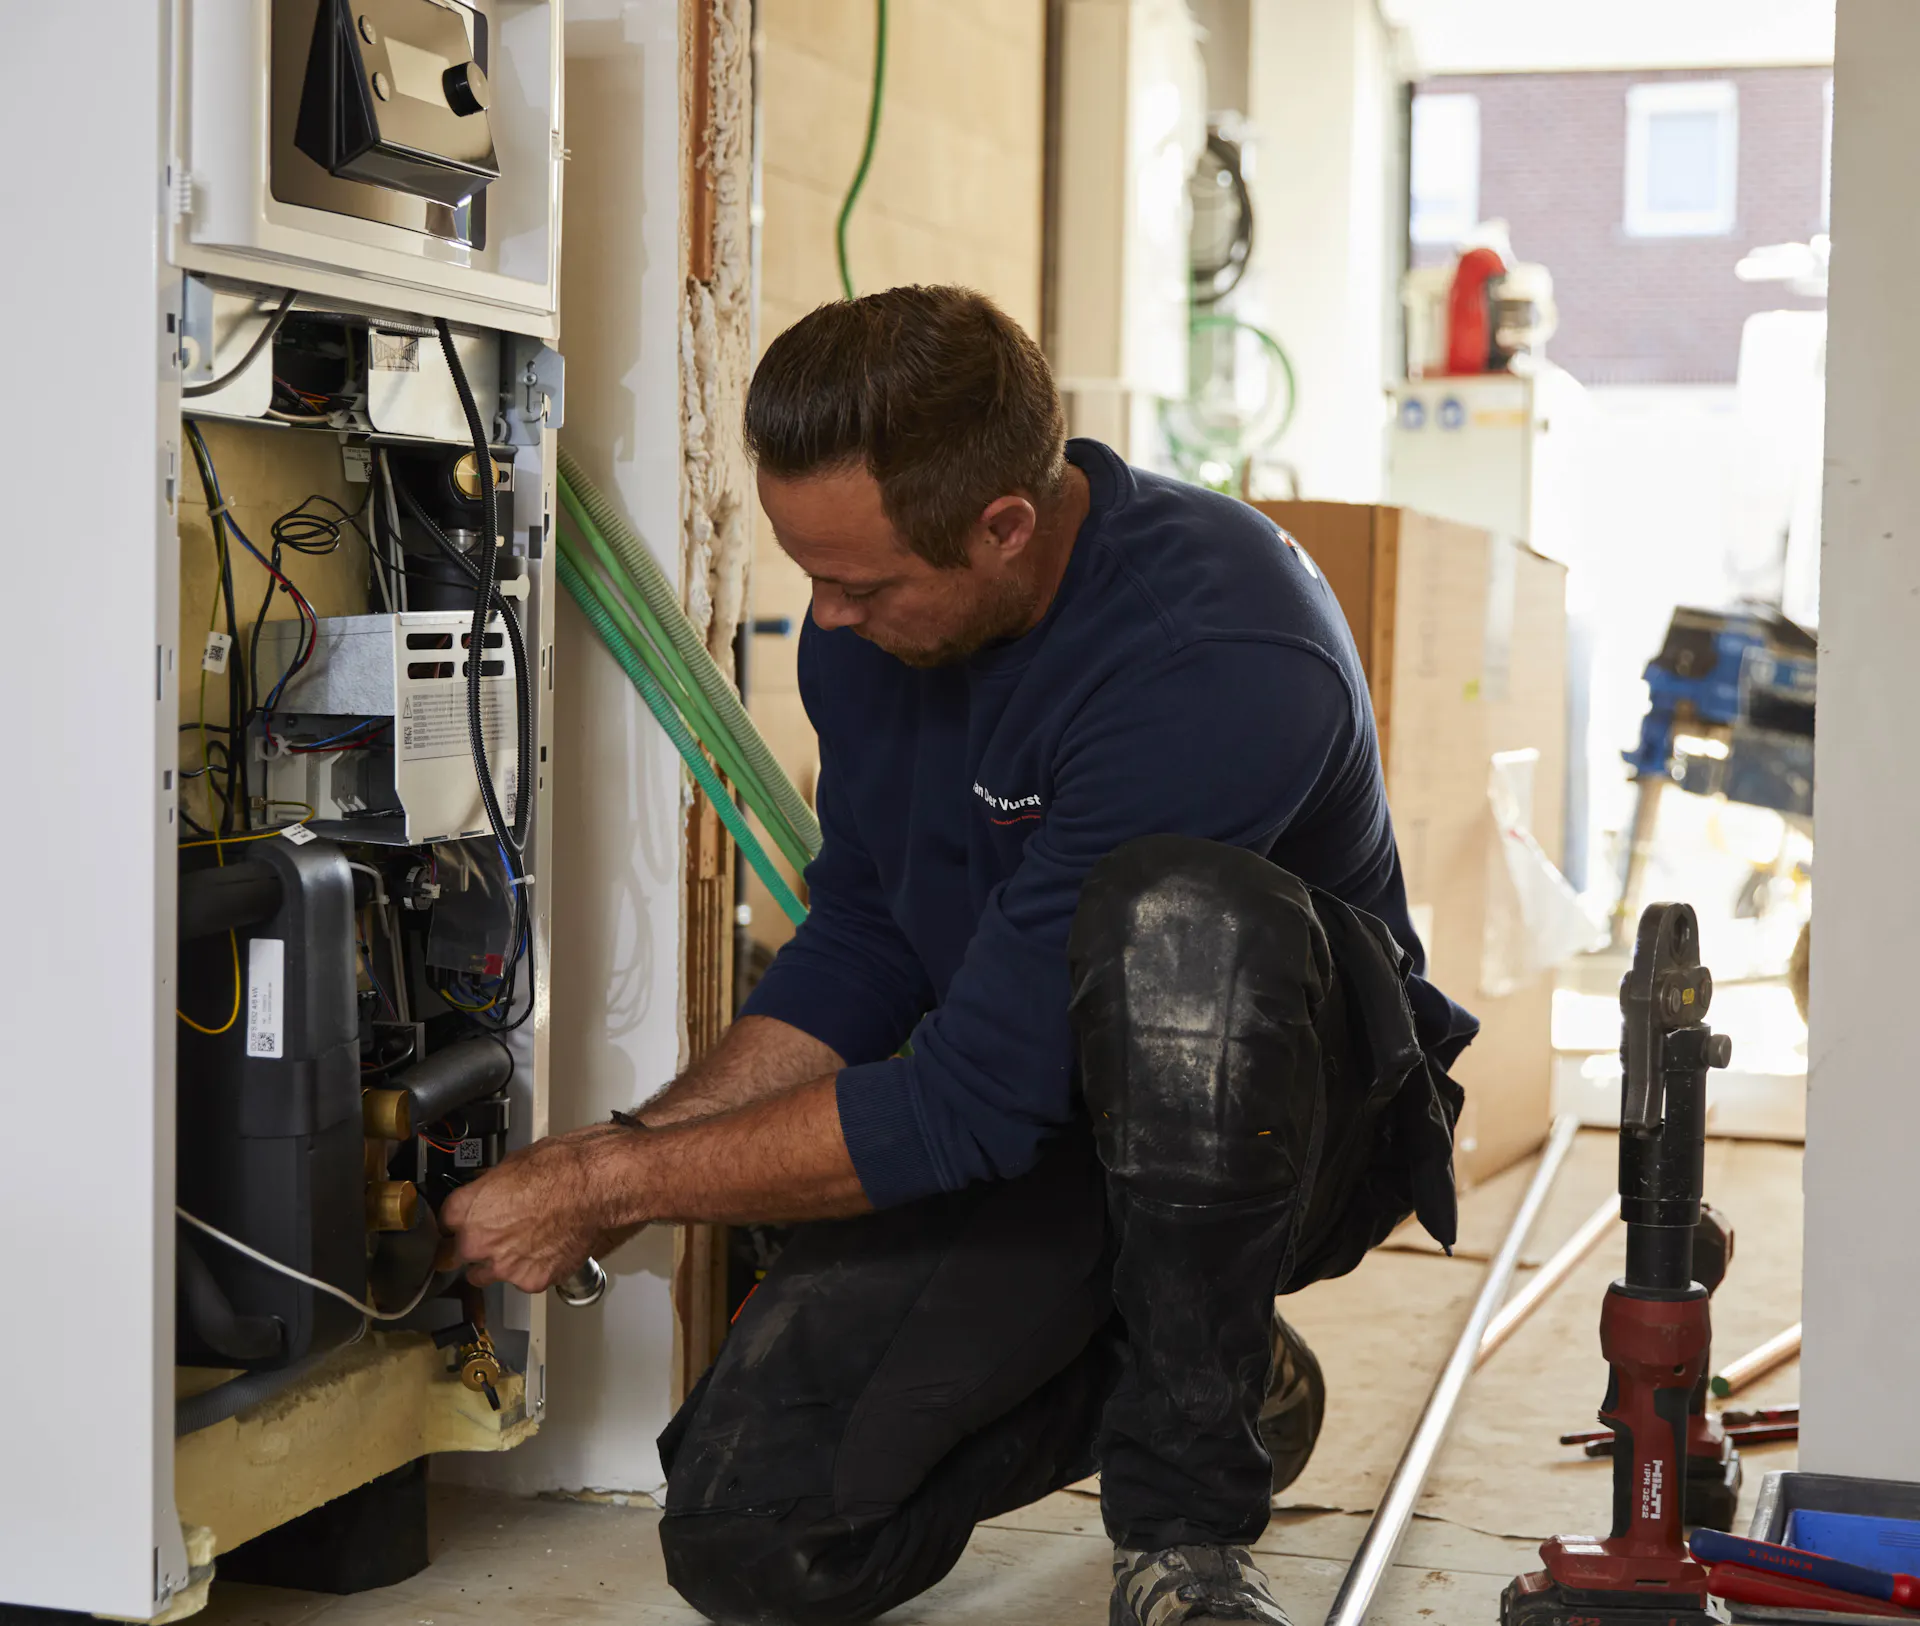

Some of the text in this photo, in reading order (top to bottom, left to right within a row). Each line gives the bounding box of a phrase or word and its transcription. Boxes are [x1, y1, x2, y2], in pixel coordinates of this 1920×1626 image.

[984, 787, 997, 808] Der
[998, 794, 1042, 811] Vurst
[1641, 1487, 1650, 1519] 32-22
[1650, 1459, 1664, 1519] HILTI
[1748, 1547, 1813, 1572] KNIPEX
